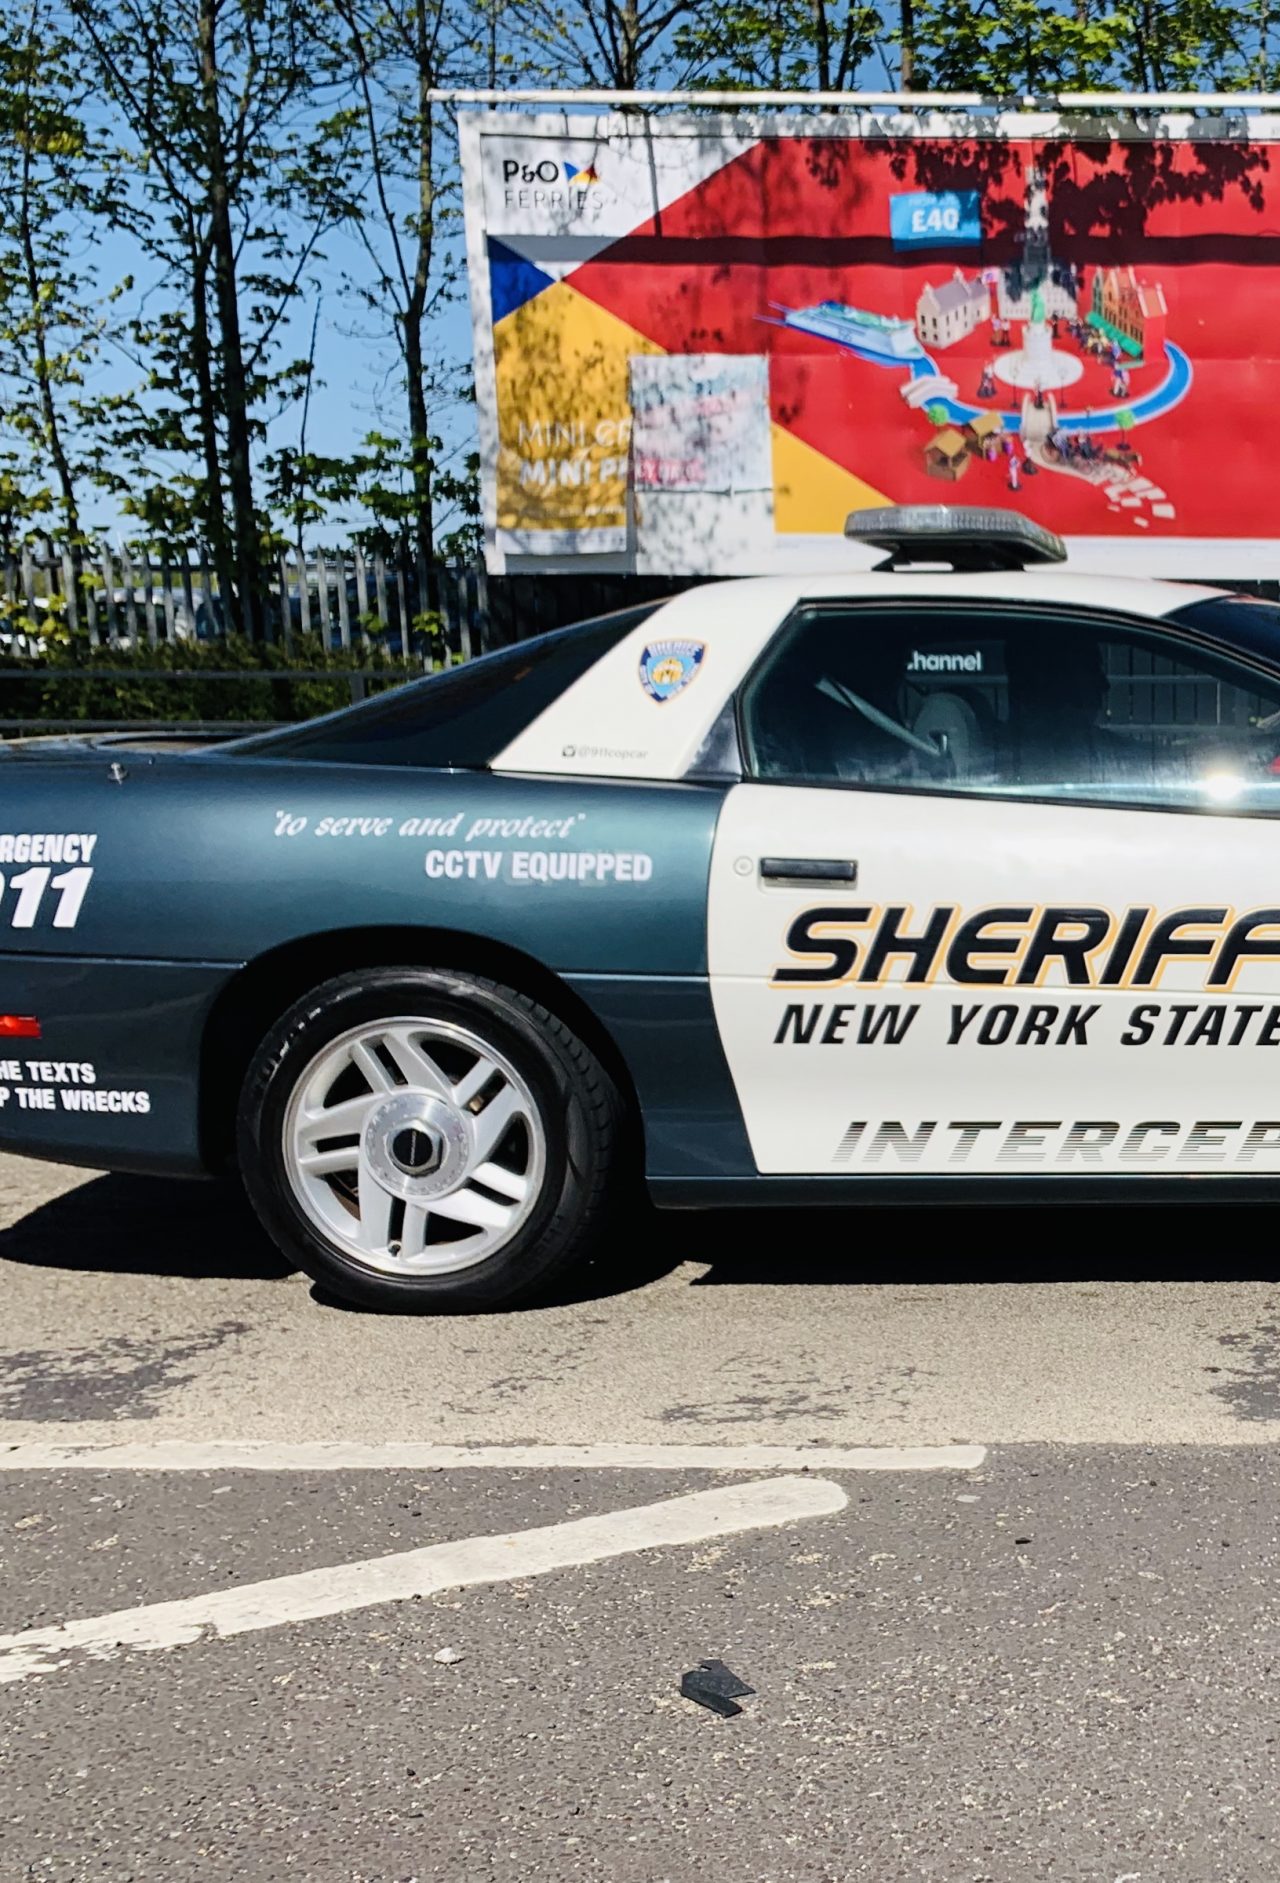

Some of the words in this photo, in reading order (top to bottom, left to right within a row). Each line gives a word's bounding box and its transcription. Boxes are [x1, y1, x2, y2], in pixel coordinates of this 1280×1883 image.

[503, 160, 559, 183] P&O
[504, 189, 603, 210] FERRIES
[911, 208, 960, 234] £40
[518, 420, 586, 448] MINI
[519, 457, 590, 488] MINI
[906, 650, 982, 671] hannel
[314, 815, 393, 837] serve
[399, 812, 465, 837] and
[425, 849, 502, 879] CCTV
[511, 851, 653, 882] EQUIPPED
[0, 866, 94, 928] 11
[774, 1003, 921, 1045] NEW
[946, 1003, 1102, 1046] YORK
[25, 1061, 97, 1085] TEXTS
[14, 1087, 56, 1110] THE
[60, 1089, 151, 1113] WRECKS
